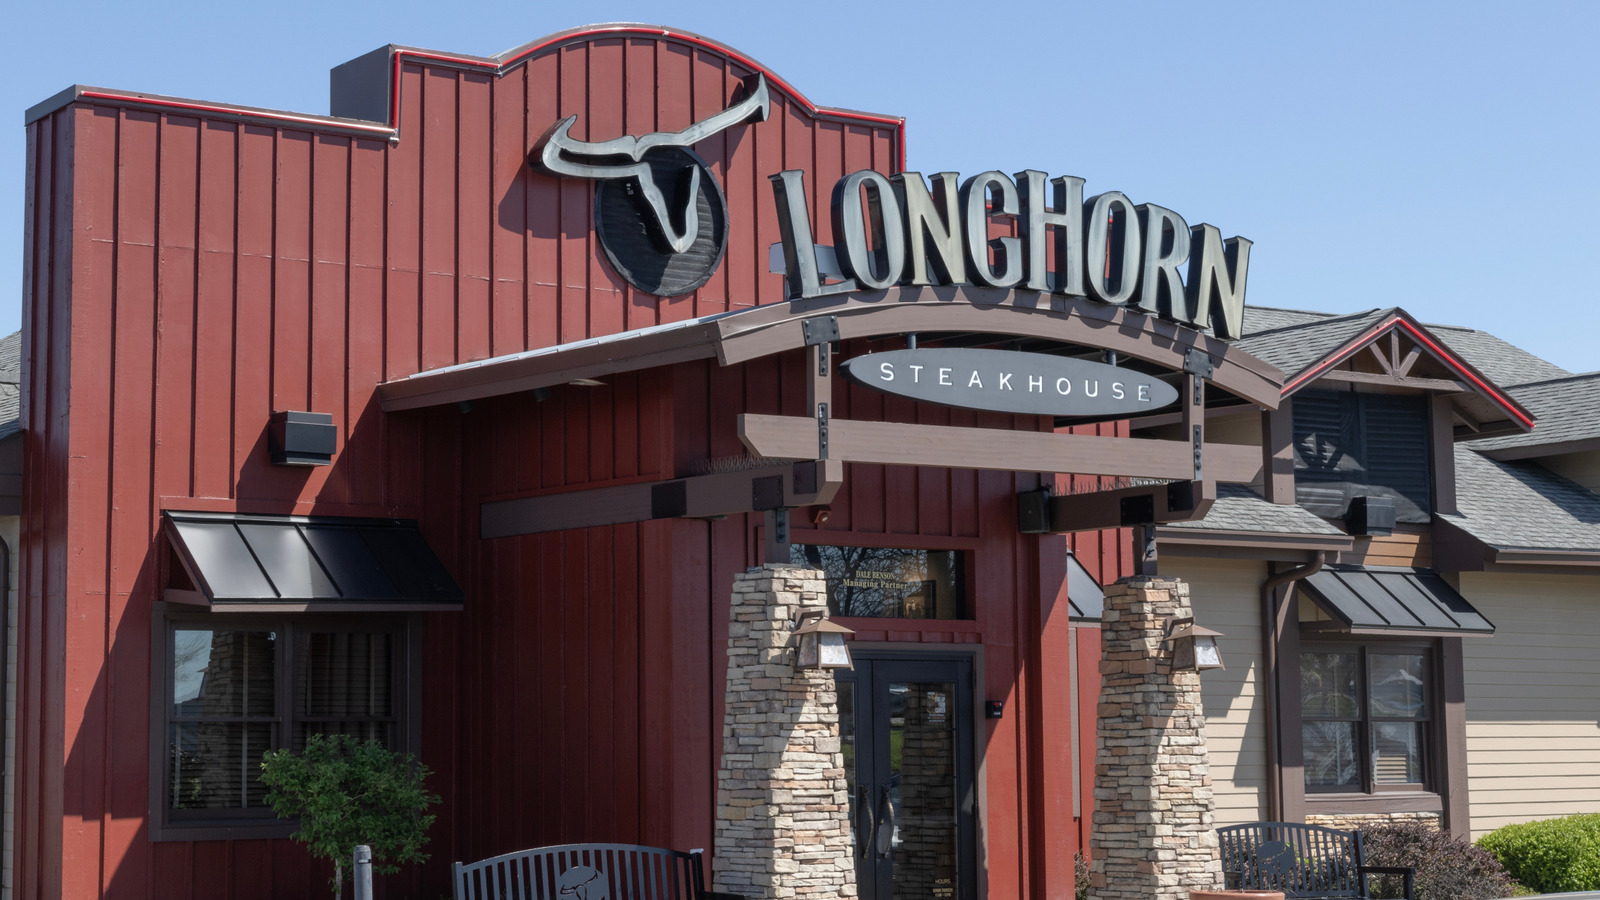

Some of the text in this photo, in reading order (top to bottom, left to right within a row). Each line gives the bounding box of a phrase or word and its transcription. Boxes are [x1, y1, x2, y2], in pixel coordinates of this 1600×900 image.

[768, 168, 1254, 340] LONGHORN
[880, 362, 1152, 402] STEAKHOUSE
[842, 578, 908, 589] Managing Partner
[855, 570, 872, 579] DALE
